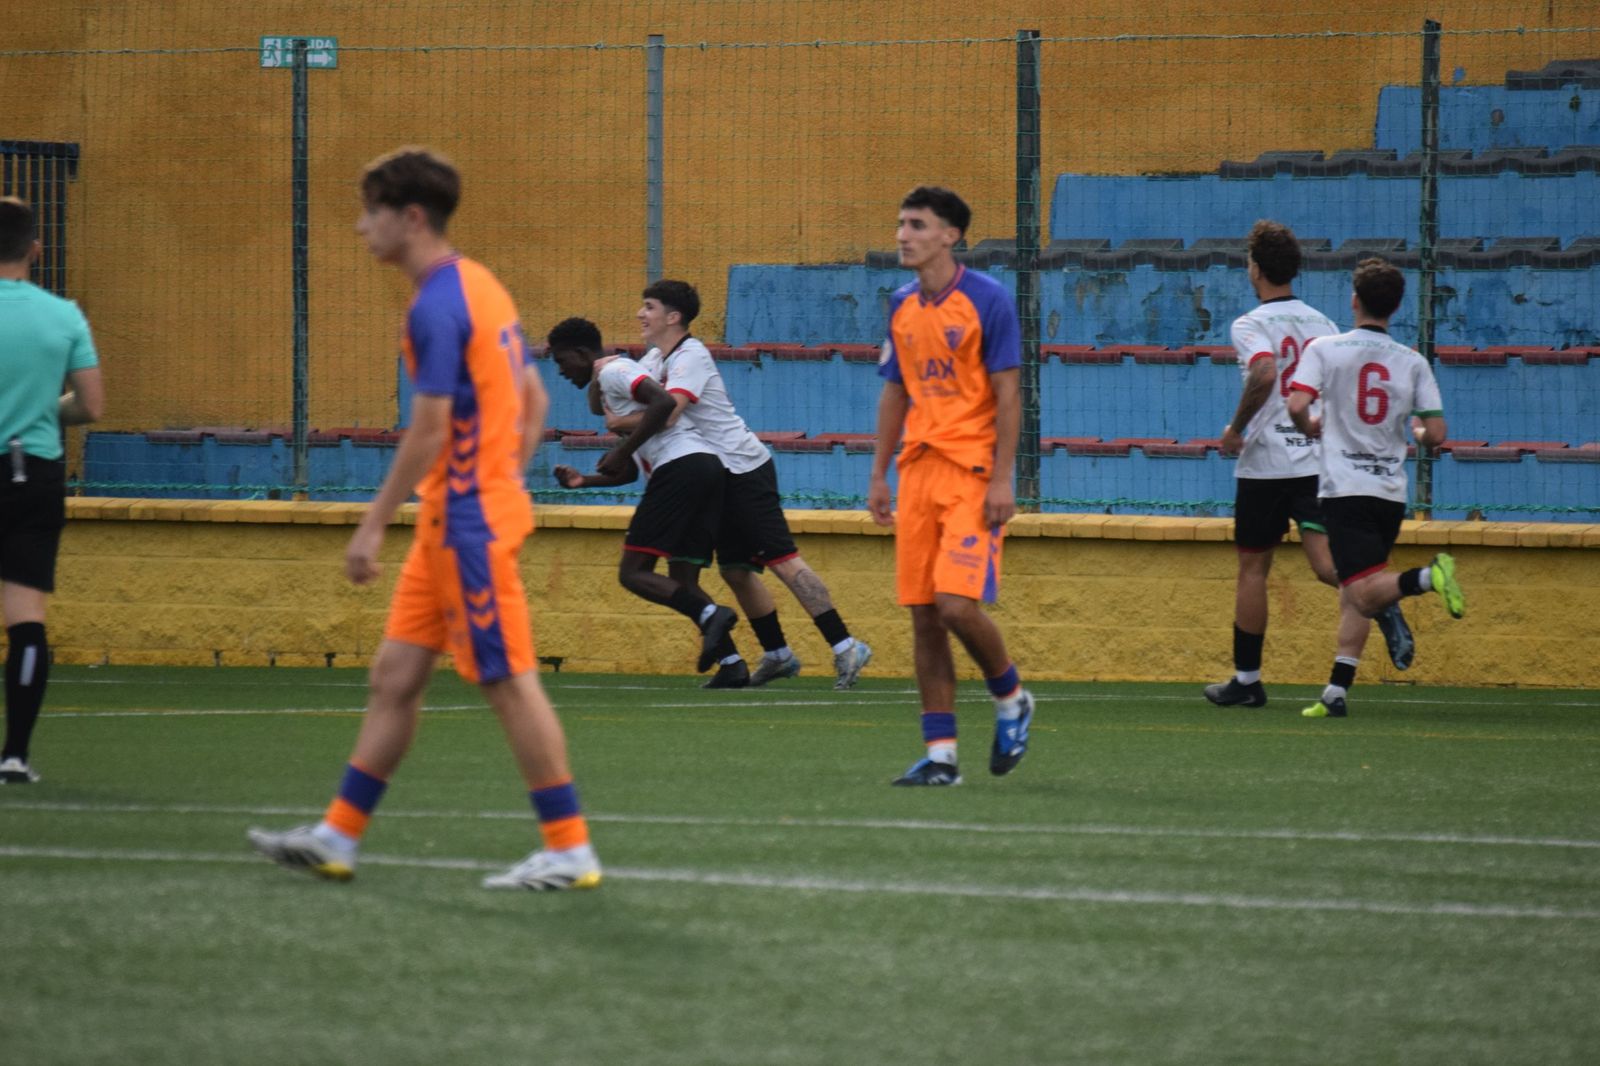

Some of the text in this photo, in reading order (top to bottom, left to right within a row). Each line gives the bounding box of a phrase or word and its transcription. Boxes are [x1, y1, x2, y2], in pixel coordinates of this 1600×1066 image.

[286, 39, 333, 49] SIDA
[1281, 335, 1318, 398] 2
[1358, 362, 1390, 426] 6
